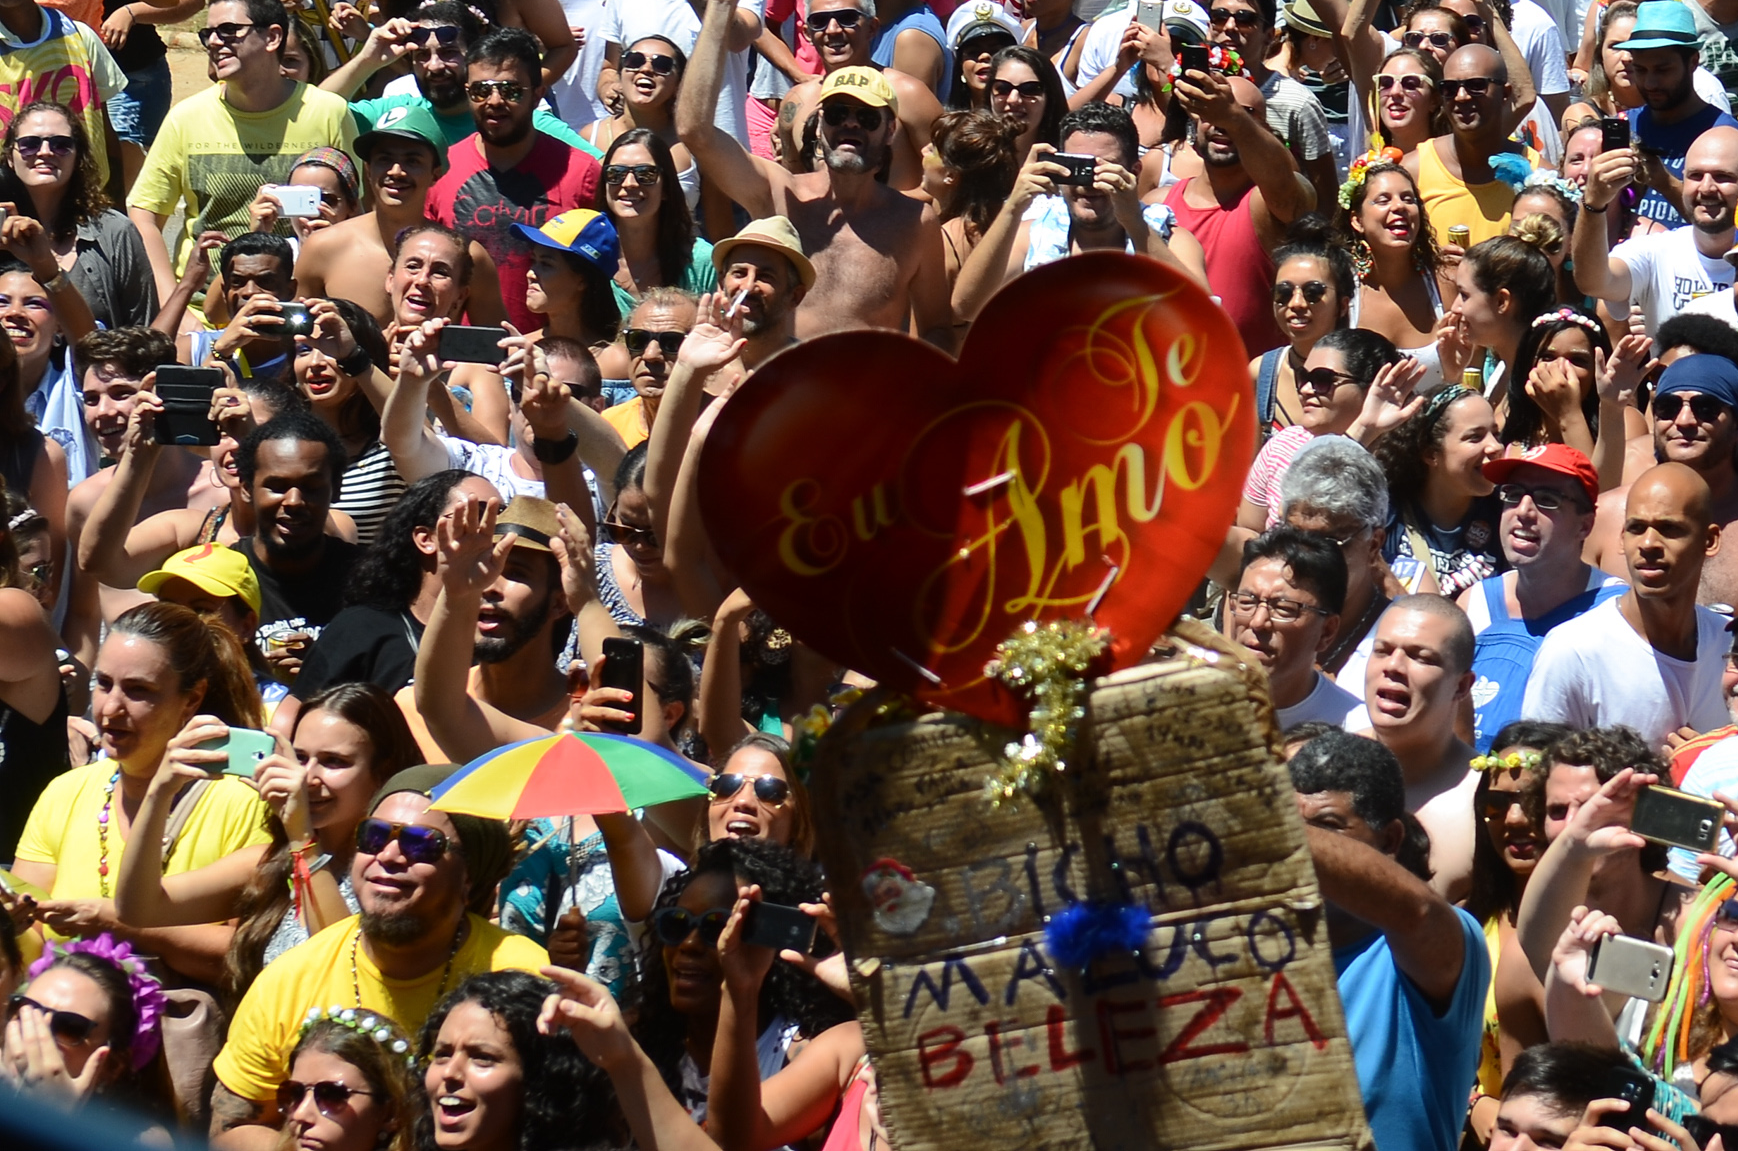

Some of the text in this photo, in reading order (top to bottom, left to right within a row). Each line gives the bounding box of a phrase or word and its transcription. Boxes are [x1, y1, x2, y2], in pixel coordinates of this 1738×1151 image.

[188, 140, 320, 151] FOR THE WILDERNESS
[1060, 283, 1207, 445] Te
[773, 477, 893, 577] Eu
[915, 394, 1240, 647] Amo
[961, 819, 1225, 930] BICHO
[917, 971, 1329, 1089] BELEZA
